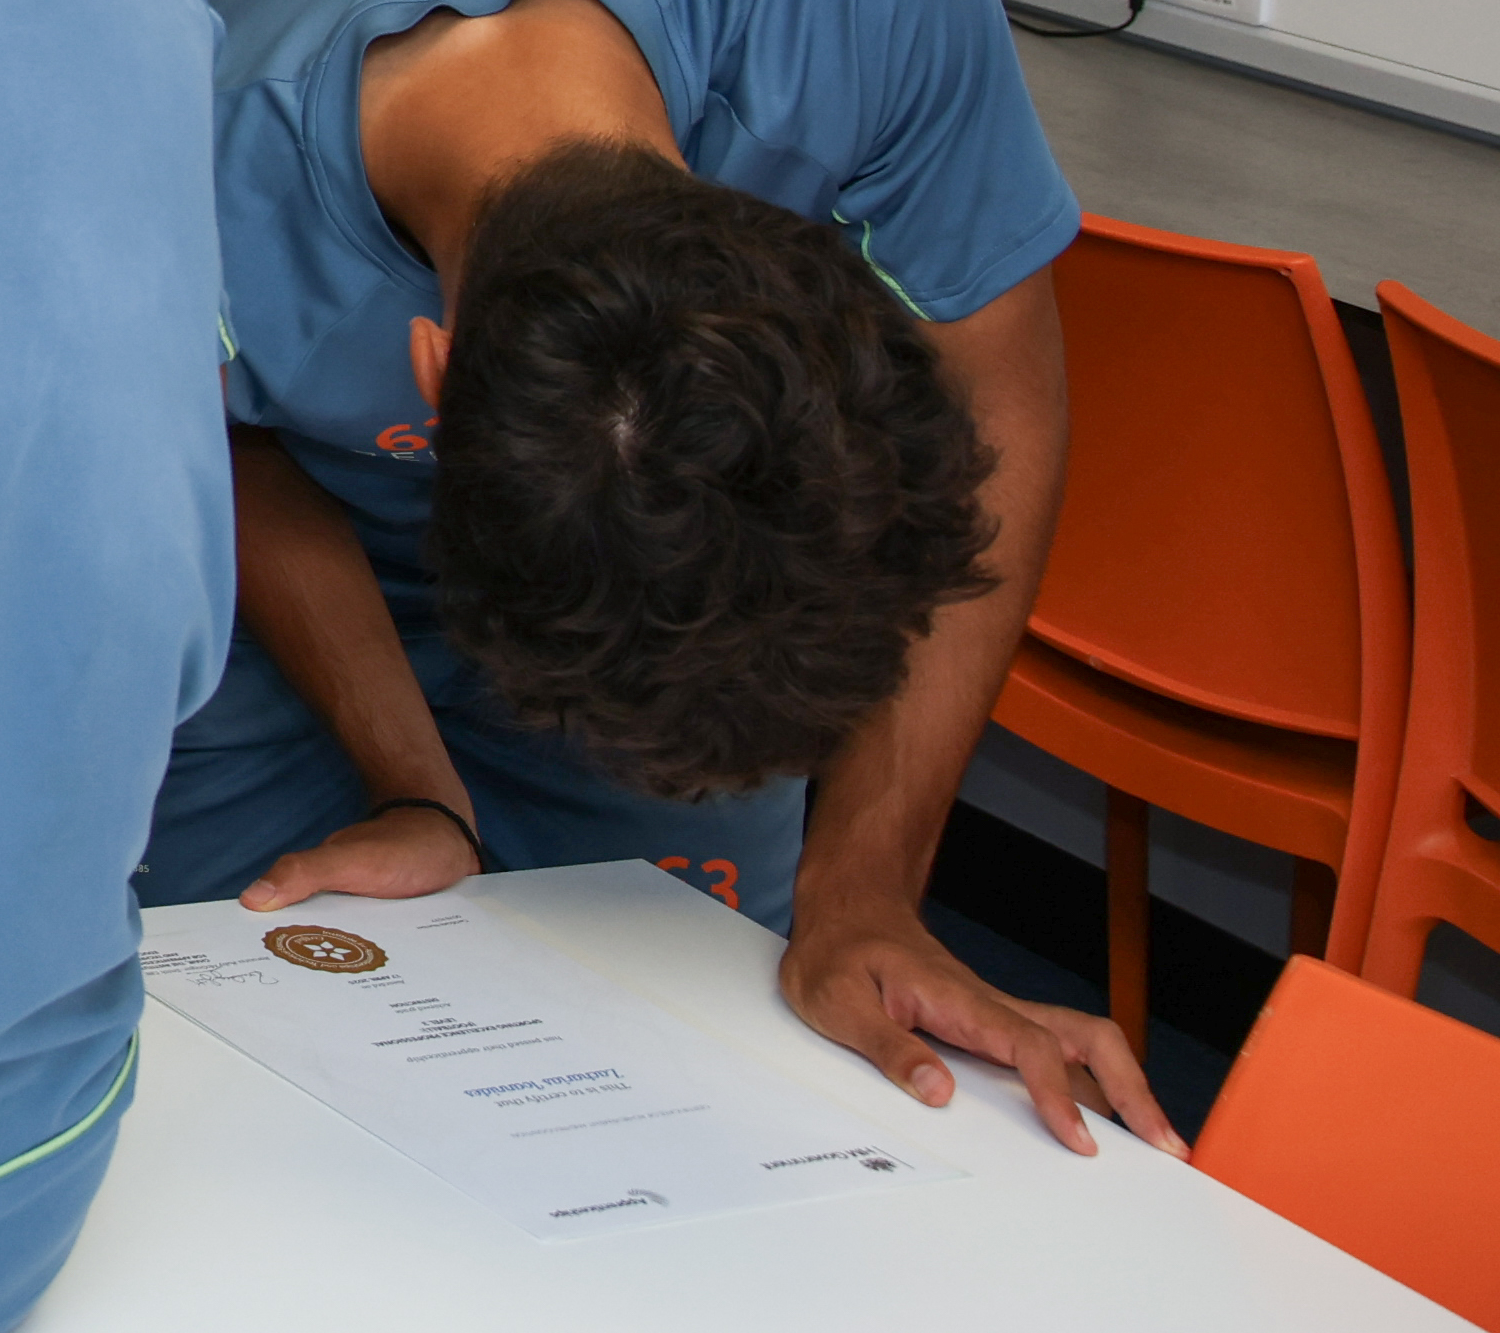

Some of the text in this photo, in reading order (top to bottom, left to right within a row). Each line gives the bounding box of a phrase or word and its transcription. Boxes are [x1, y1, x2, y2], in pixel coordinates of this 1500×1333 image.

[376, 415, 440, 452] 6
[370, 1018, 543, 1047] SPORTING EXCELLENCE PROFESSIONAL
[430, 1017, 457, 1026] LEVEL
[405, 1034, 563, 1065] has passed their apprenticeship
[542, 1068, 624, 1088] Zacharias
[493, 1081, 631, 1110] This is to certify that
[759, 1145, 876, 1172] HM Government
[548, 1197, 648, 1220] Apprenticeships
